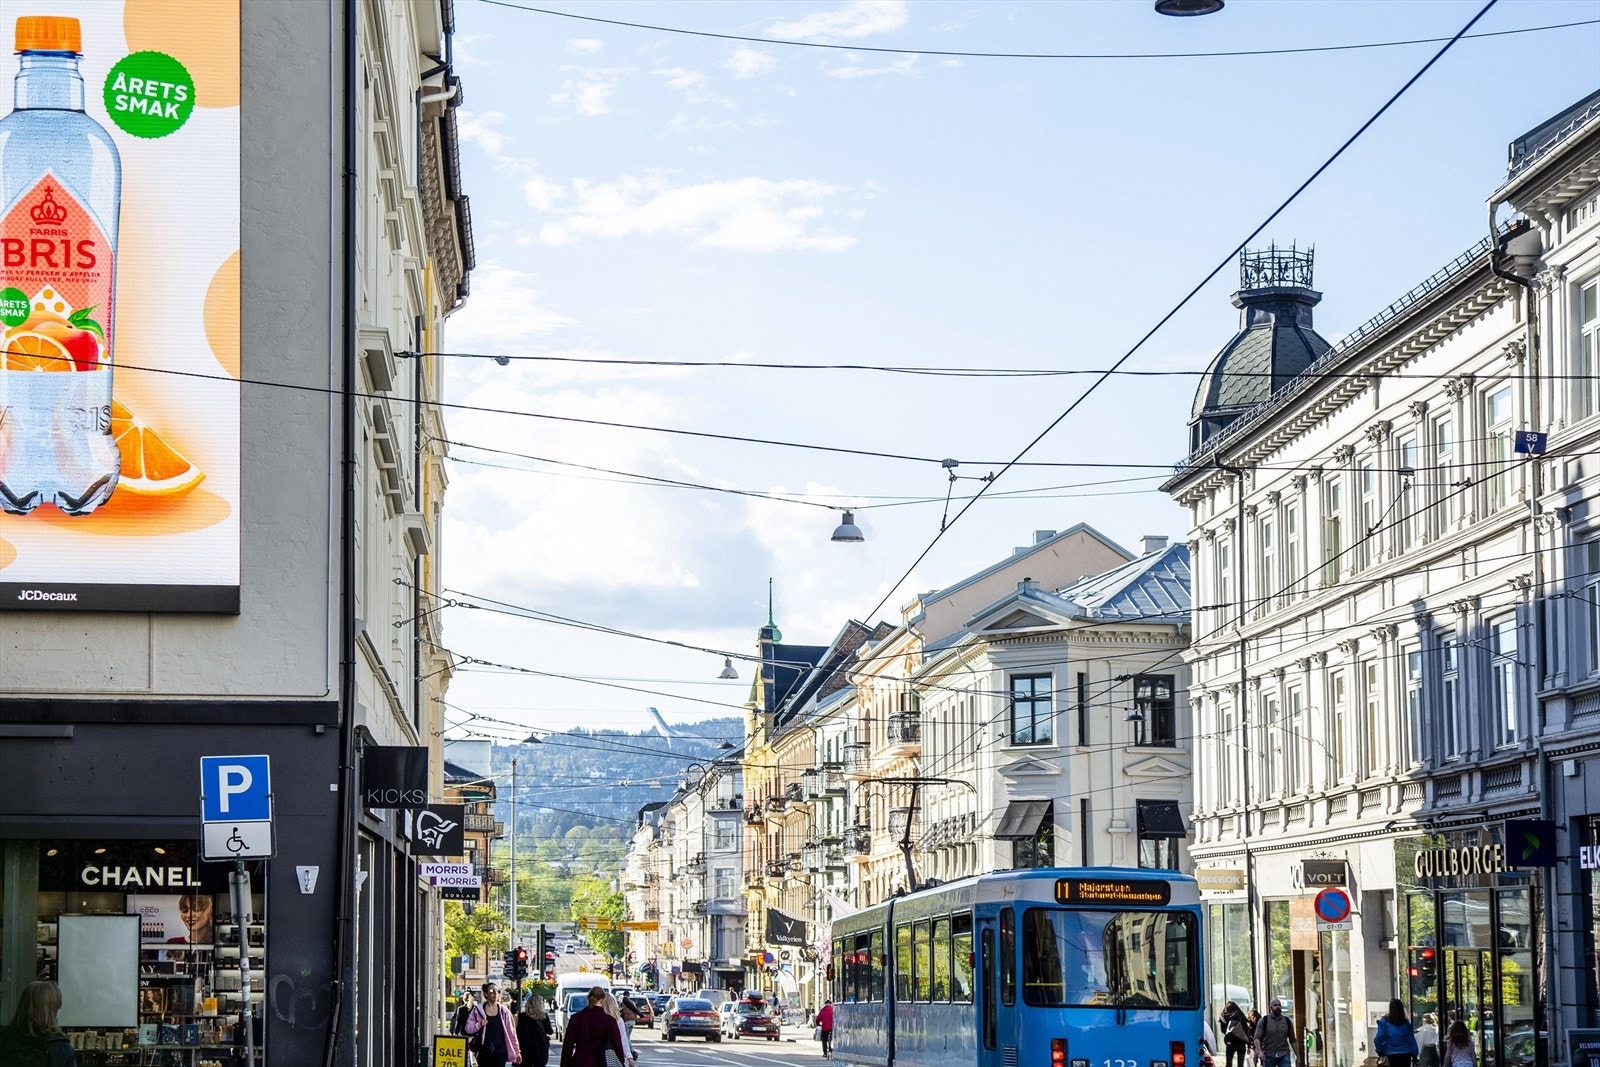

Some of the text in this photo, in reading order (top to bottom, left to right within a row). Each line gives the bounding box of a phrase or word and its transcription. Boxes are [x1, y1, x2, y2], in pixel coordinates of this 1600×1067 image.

[112, 72, 188, 102] ÅRETS
[114, 94, 180, 120] SMAK
[29, 228, 68, 237] FARRIS
[1, 238, 97, 269] BRIS
[1526, 433, 1538, 442] 58
[1527, 444, 1535, 453] V
[18, 590, 77, 601] JCDecaux
[218, 765, 253, 813] P
[367, 788, 424, 804] KICKS
[1414, 843, 1520, 878] GULLBORGE
[426, 865, 469, 875] MORRIS
[81, 866, 202, 886] CHANEL
[440, 877, 478, 886] MORRIS
[1200, 875, 1241, 884] BIK BOK
[1306, 873, 1344, 883] VOLT
[1057, 882, 1131, 899] 11 Majorstuen
[776, 934, 803, 944] Valkyrien
[439, 1047, 463, 1058] SALE
